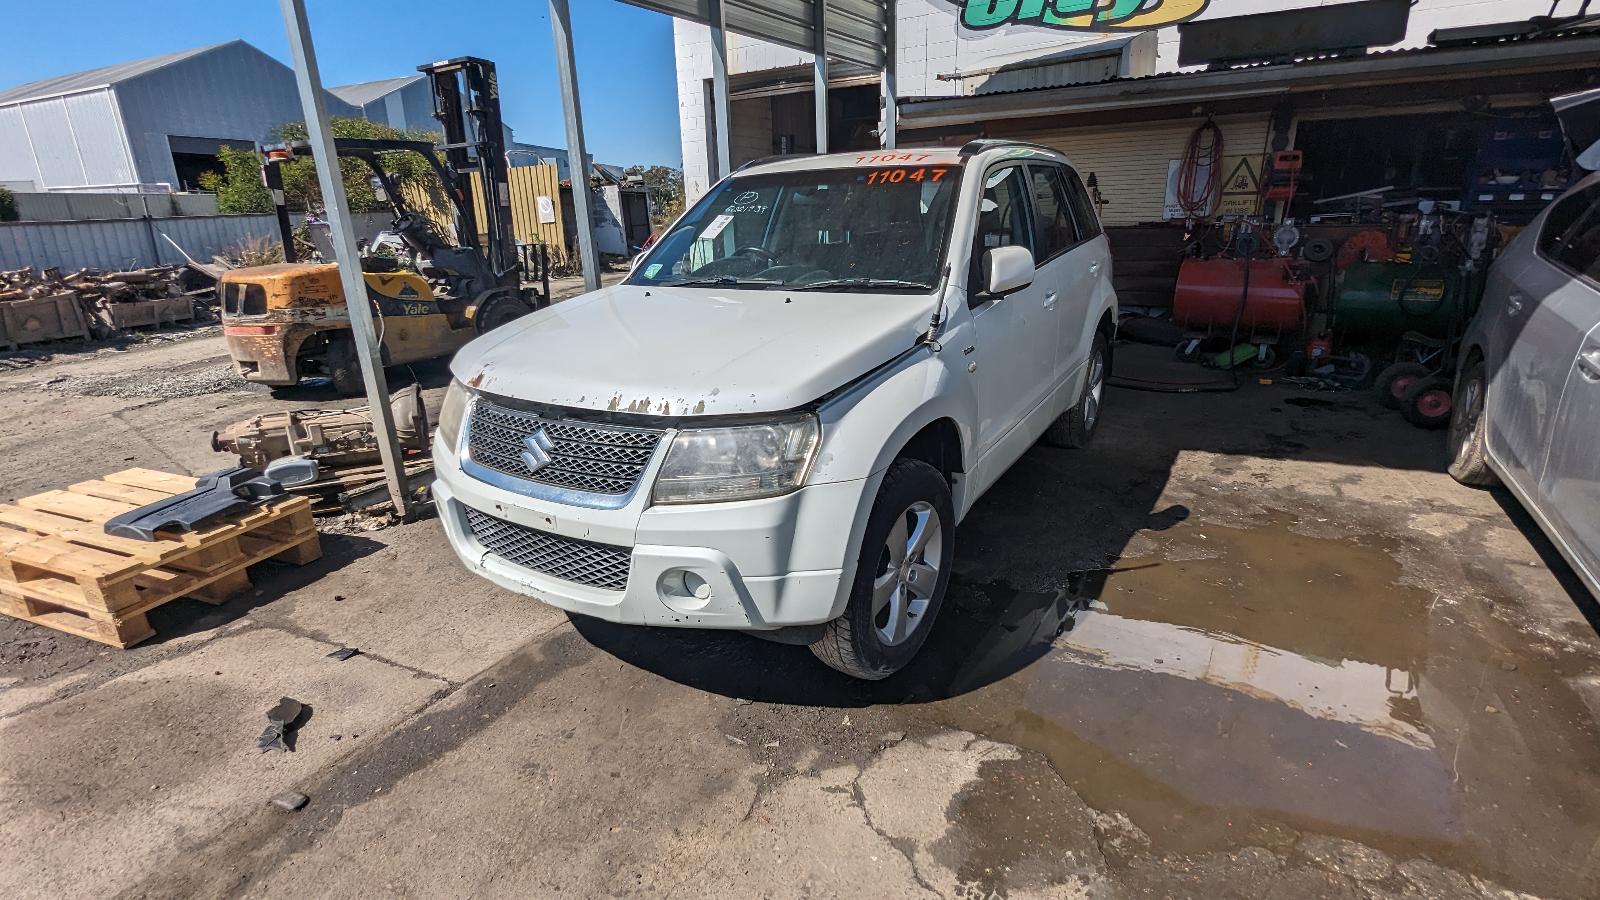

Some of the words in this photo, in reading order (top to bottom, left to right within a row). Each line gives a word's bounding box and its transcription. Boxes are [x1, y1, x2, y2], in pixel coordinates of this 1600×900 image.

[488, 71, 498, 99] Yale
[856, 153, 931, 164] 11047
[867, 168, 946, 185] 11047
[403, 303, 429, 315] Yale
